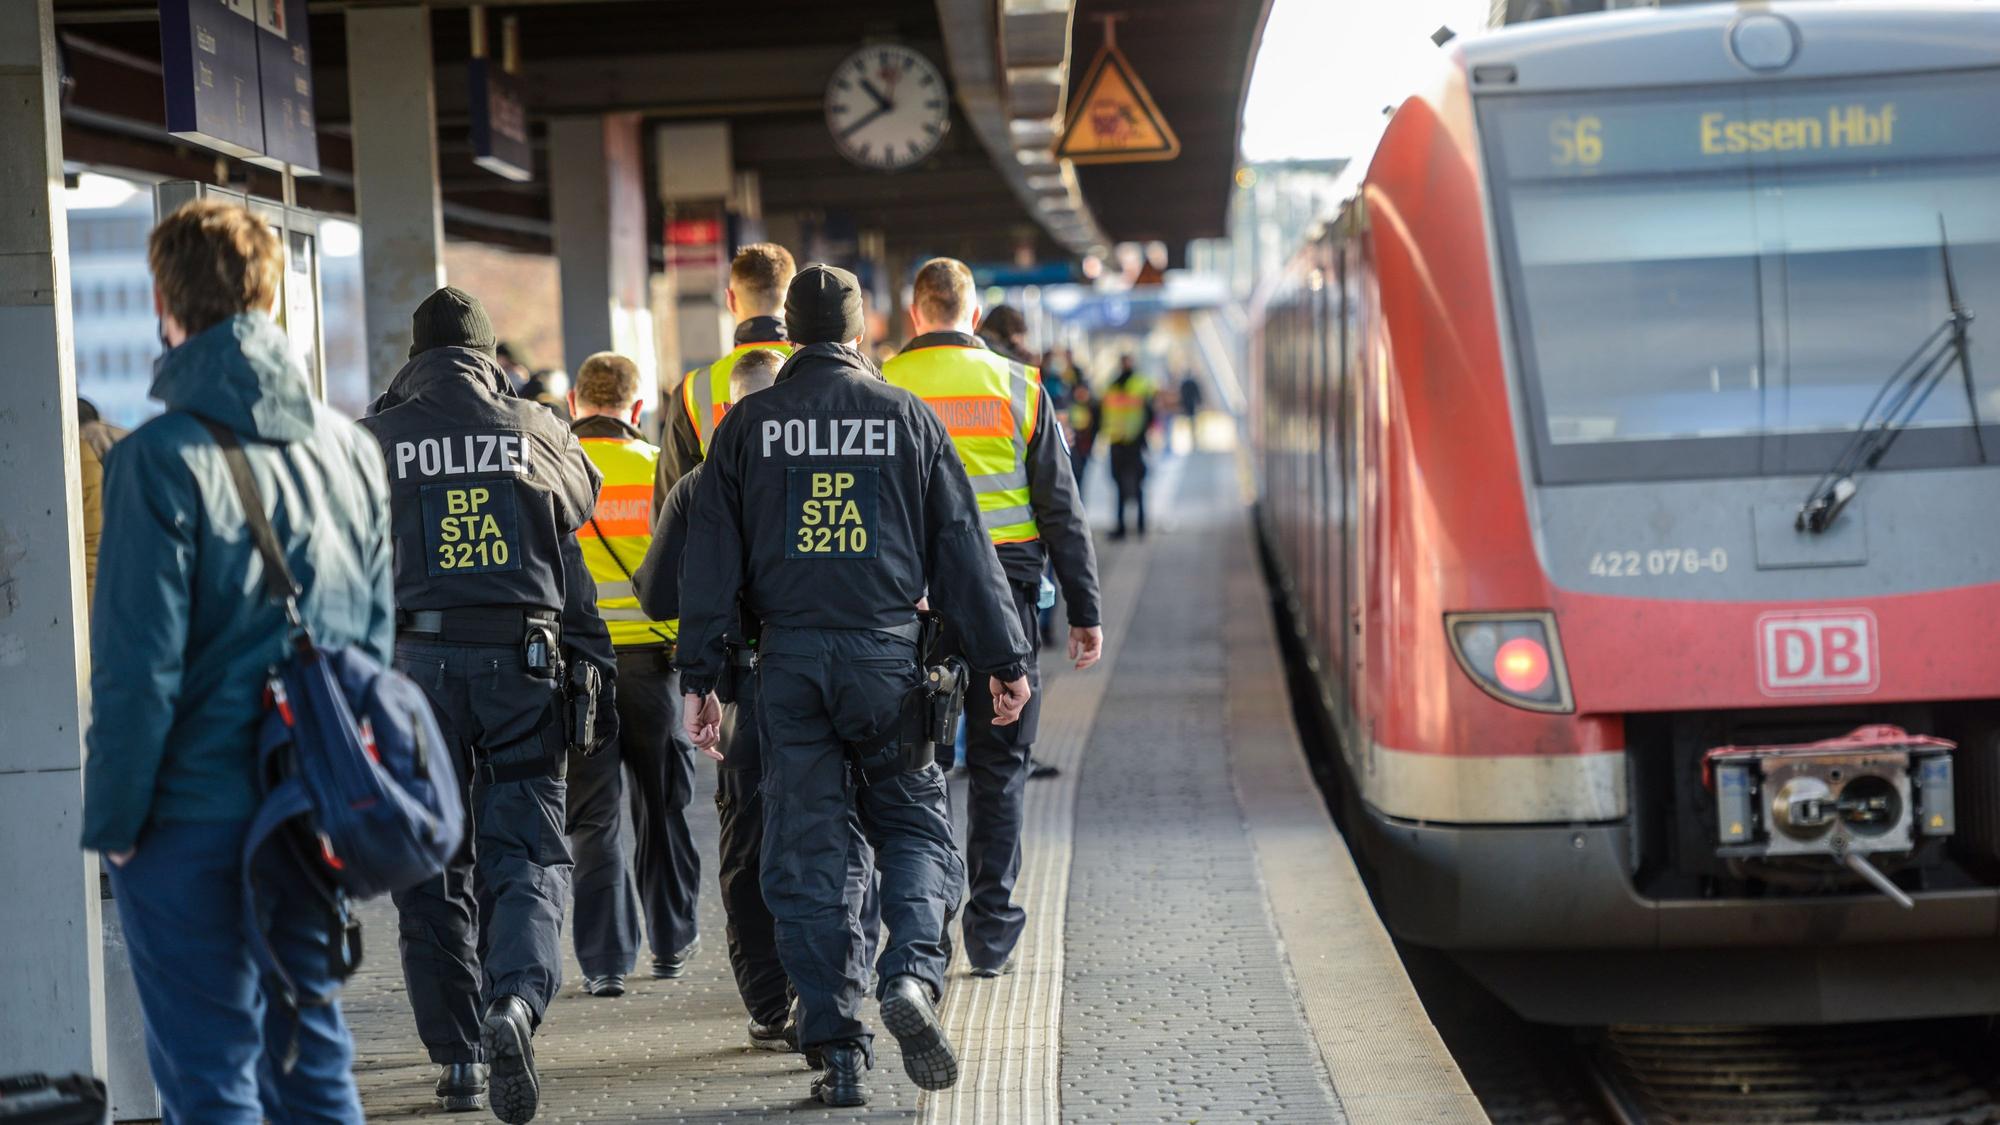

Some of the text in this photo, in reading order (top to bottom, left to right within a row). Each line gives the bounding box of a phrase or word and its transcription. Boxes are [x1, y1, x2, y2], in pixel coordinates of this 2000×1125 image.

[1551, 115, 1603, 167] S6
[1701, 102, 1897, 155] Essen Hbf
[761, 418, 897, 458] POLIZEI
[395, 434, 530, 480] POLIZEI
[811, 472, 855, 498] BP
[446, 487, 490, 515] BP
[801, 499, 863, 526] STA
[440, 513, 502, 542] STA
[797, 526, 868, 553] 3210
[438, 539, 509, 569] 3210
[1589, 547, 1728, 578] 422 076-0
[1773, 624, 1864, 681] DB
